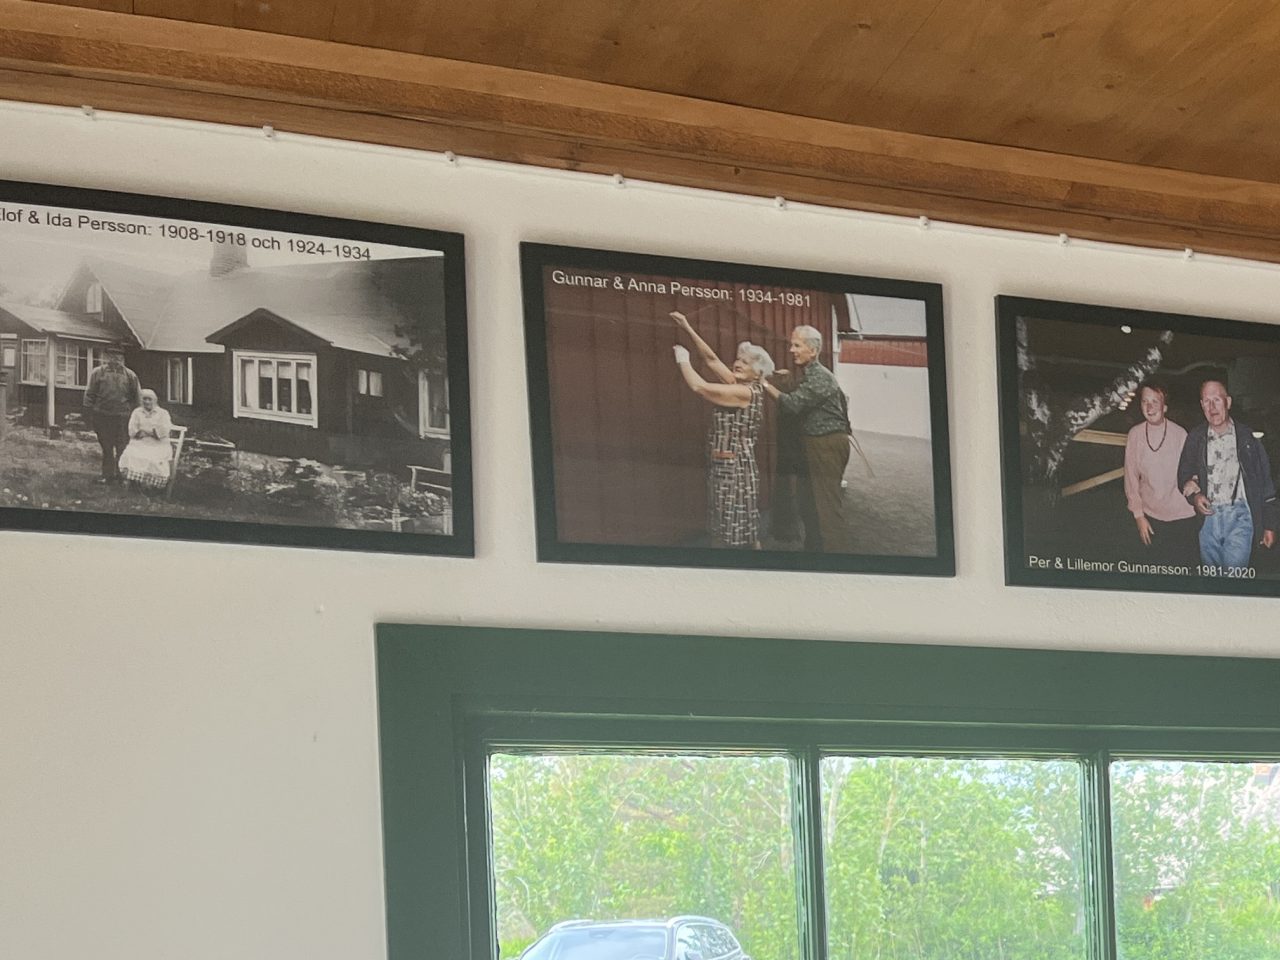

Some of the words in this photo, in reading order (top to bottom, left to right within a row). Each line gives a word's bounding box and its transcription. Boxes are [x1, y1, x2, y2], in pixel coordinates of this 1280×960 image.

[27, 210, 41, 224] &
[46, 211, 73, 227] Ida
[77, 214, 153, 236] Persson:
[158, 223, 247, 246] 1908-1918
[251, 236, 281, 251] och
[286, 239, 372, 261] 1924-1934
[552, 270, 608, 288] Gunnar
[613, 276, 625, 290] &
[627, 277, 666, 294] Anna
[670, 282, 733, 300] Persson:
[738, 289, 811, 308] 1934-1981
[1029, 555, 1051, 568] Per
[1054, 557, 1064, 569] &
[1067, 558, 1114, 572] Lillemor
[1117, 560, 1193, 576] Gunnarsson:
[1196, 565, 1256, 579] 1981-2020
